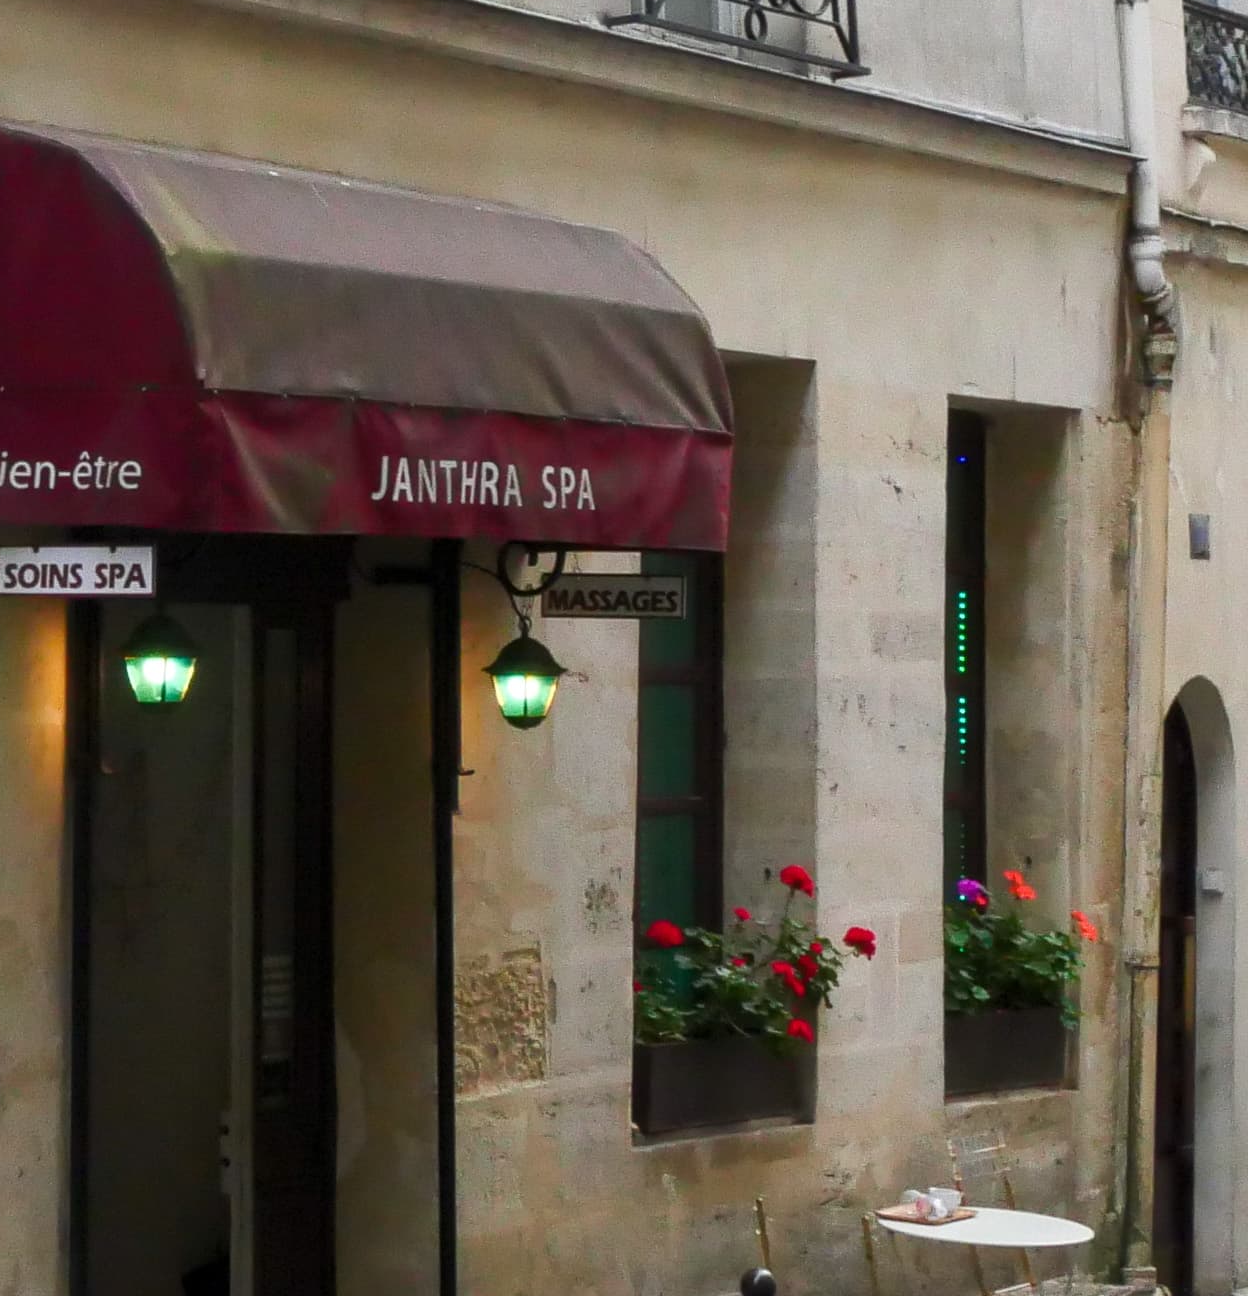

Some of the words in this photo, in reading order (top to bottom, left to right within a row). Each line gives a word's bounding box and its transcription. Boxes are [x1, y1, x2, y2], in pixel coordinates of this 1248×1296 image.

[371, 455, 523, 507] JANTHRA
[541, 465, 596, 511] SPA
[3, 563, 83, 589] SOINS
[94, 563, 147, 589] SPA
[549, 589, 679, 613] MASSAGES
